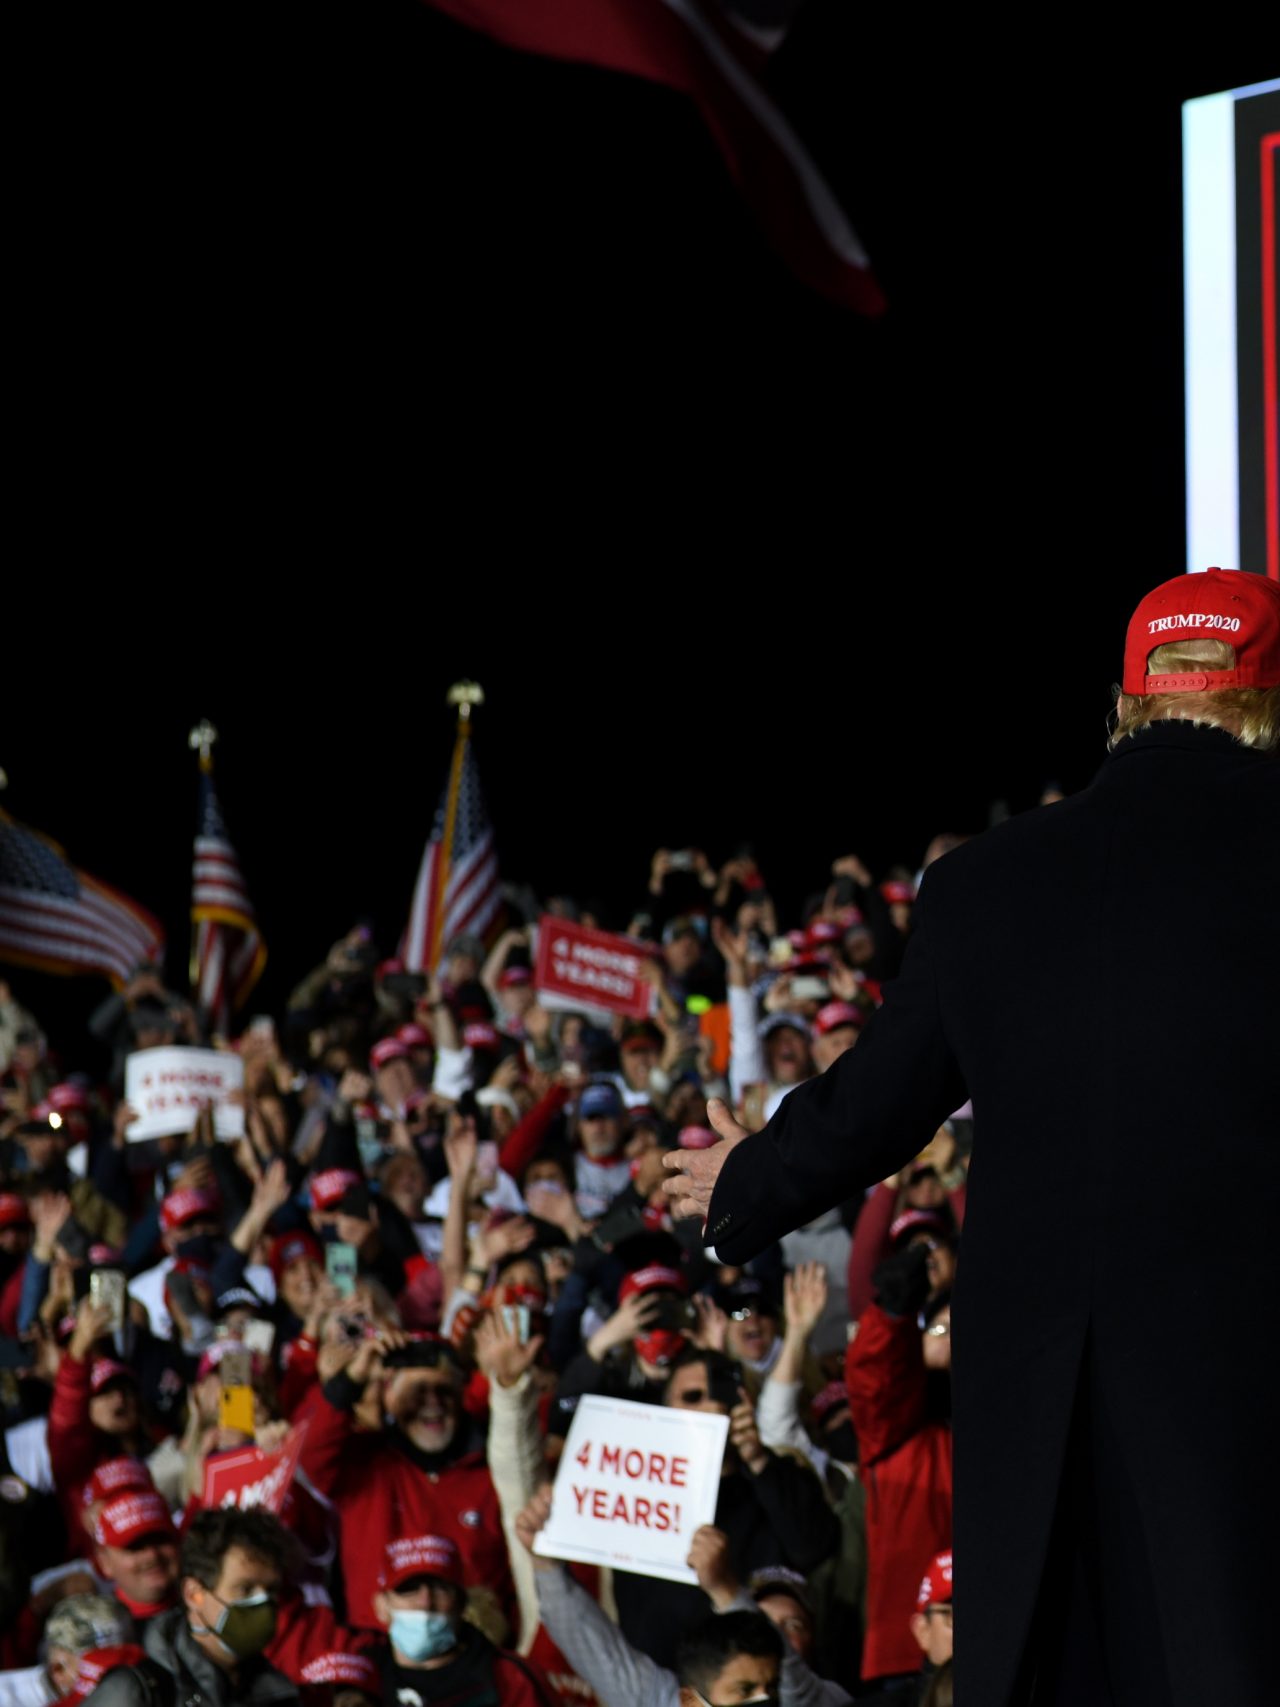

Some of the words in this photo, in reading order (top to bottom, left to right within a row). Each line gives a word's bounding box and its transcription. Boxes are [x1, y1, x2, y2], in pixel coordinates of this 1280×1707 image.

[1148, 613, 1240, 634] TRUMP2020
[575, 1440, 592, 1468] 4
[600, 1443, 689, 1487] MORE
[572, 1484, 682, 1533] YEARS!
